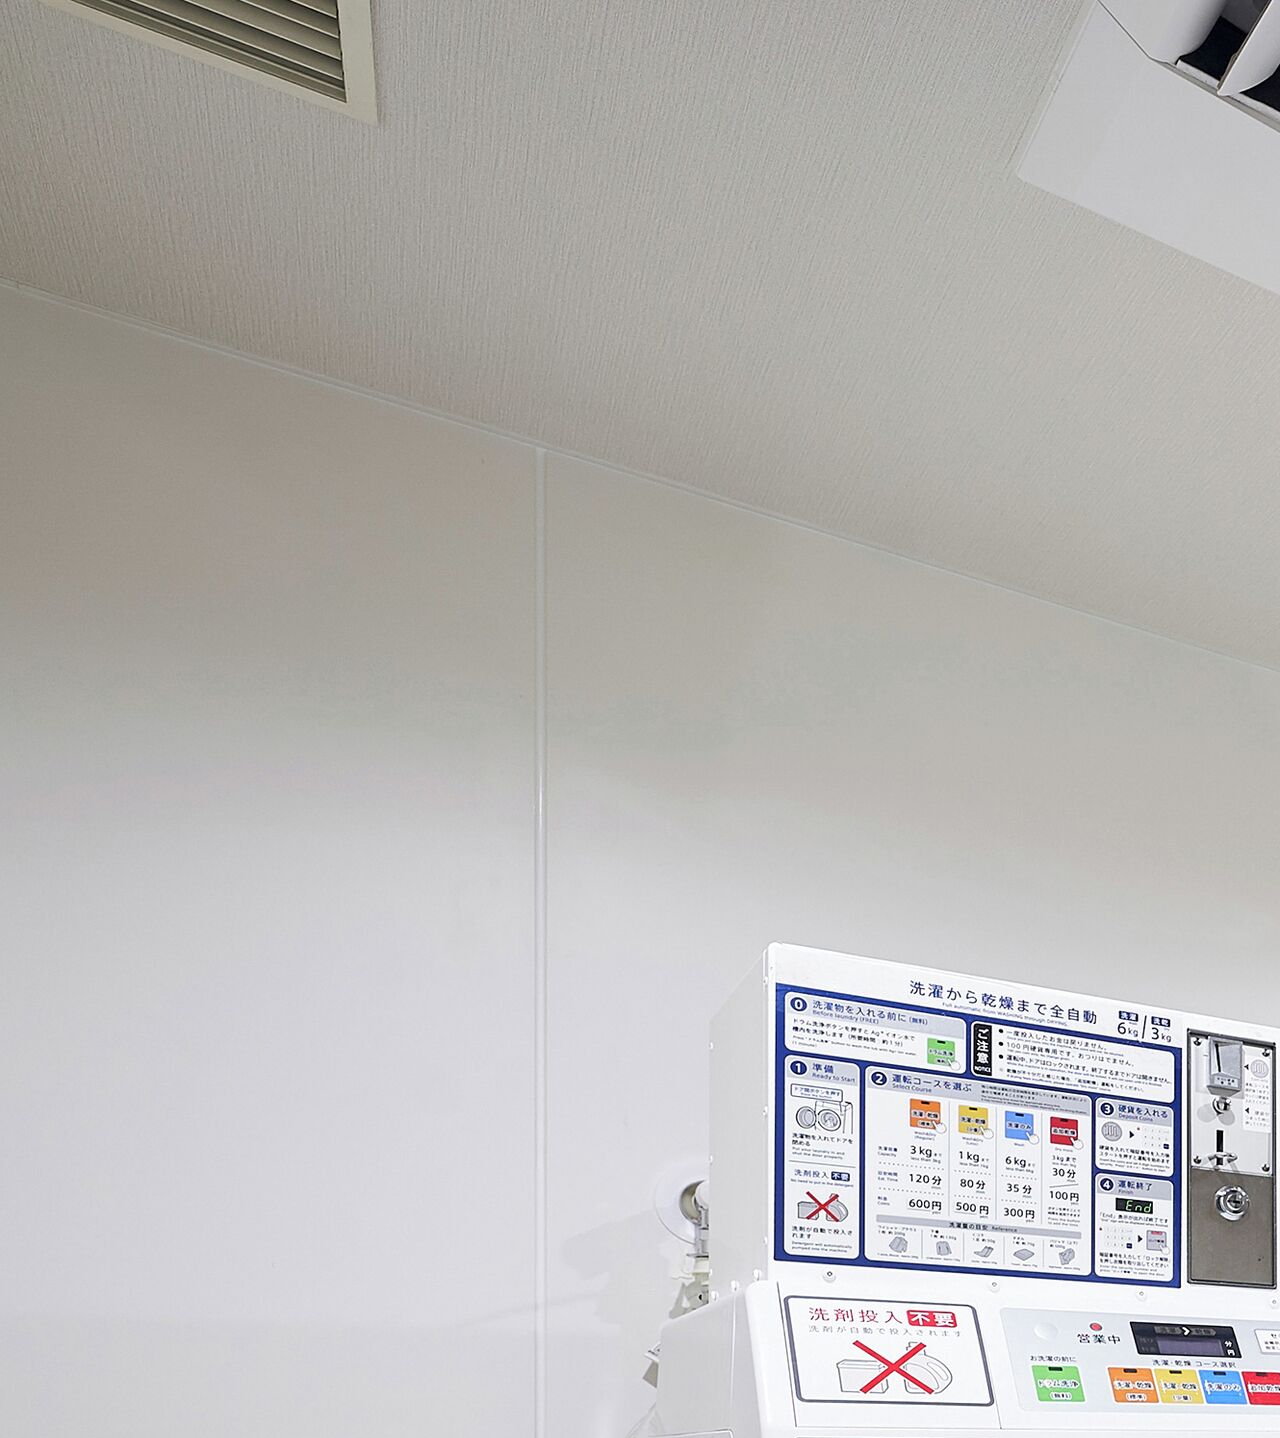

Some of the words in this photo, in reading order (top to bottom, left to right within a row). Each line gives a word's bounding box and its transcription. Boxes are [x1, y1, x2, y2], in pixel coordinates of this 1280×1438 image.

[909, 980, 1098, 1025] 洗濯から乾燥まで全自動
[812, 1000, 907, 1023] 洗濯物を入れる前に
[812, 1062, 834, 1074] 準備
[892, 1074, 972, 1092] 運転コースを選ぶ
[1118, 1103, 1169, 1119] 硬貨を入れる
[909, 1173, 942, 1186] 120分
[1052, 1168, 1076, 1179] 30分
[960, 1178, 985, 1190] 80分
[1006, 1182, 1032, 1195] 35分
[1118, 1181, 1152, 1192] 運転終了
[1049, 1190, 1080, 1203] 100円
[908, 1198, 942, 1211] 600円
[955, 1201, 989, 1216] 500円
[1003, 1207, 1035, 1219] 300円
[808, 1306, 903, 1324] 洗剤投入
[908, 1310, 956, 1327] 不要
[1077, 1333, 1121, 1345] 営業中
